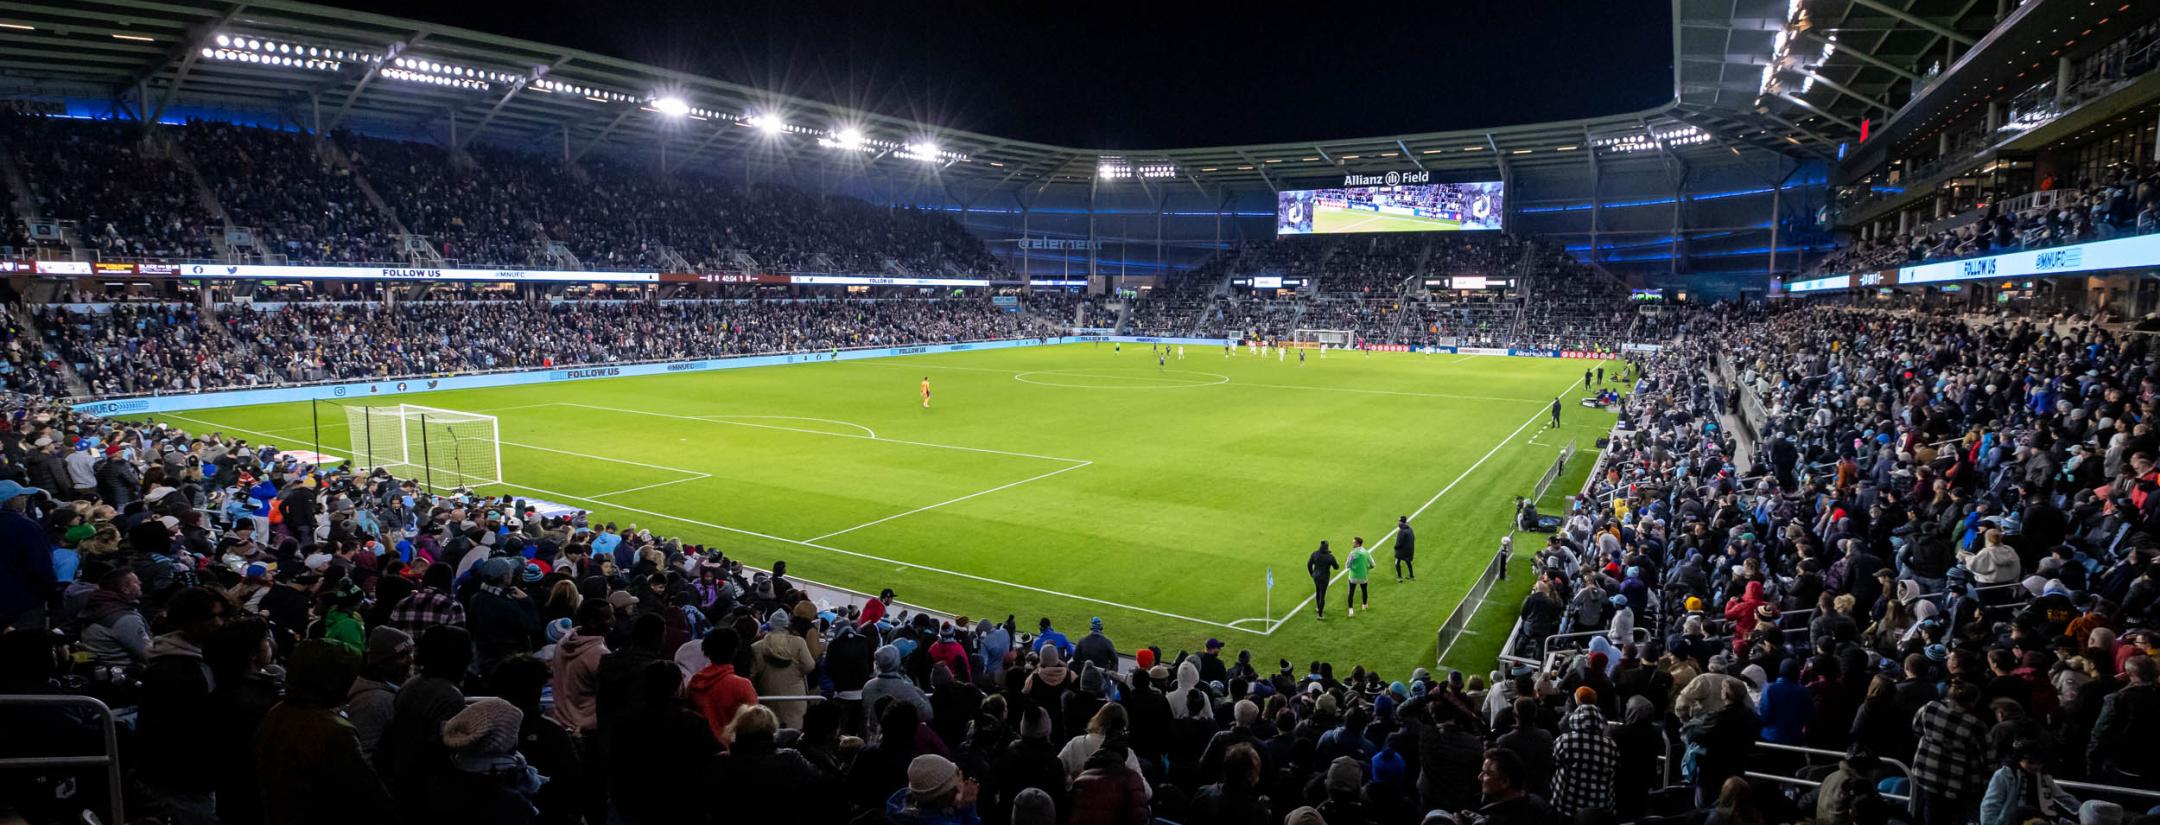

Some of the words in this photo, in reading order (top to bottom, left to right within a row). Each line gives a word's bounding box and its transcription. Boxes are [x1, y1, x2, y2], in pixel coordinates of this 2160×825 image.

[1344, 175, 1383, 186] Allianz
[1402, 171, 1429, 183] Field
[383, 269, 425, 277] FOLLOW
[428, 270, 441, 278] US
[1964, 259, 1986, 276] FOLLOW
[1987, 258, 1997, 275] US
[567, 369, 607, 379] FOLLOW
[607, 367, 620, 376] US
